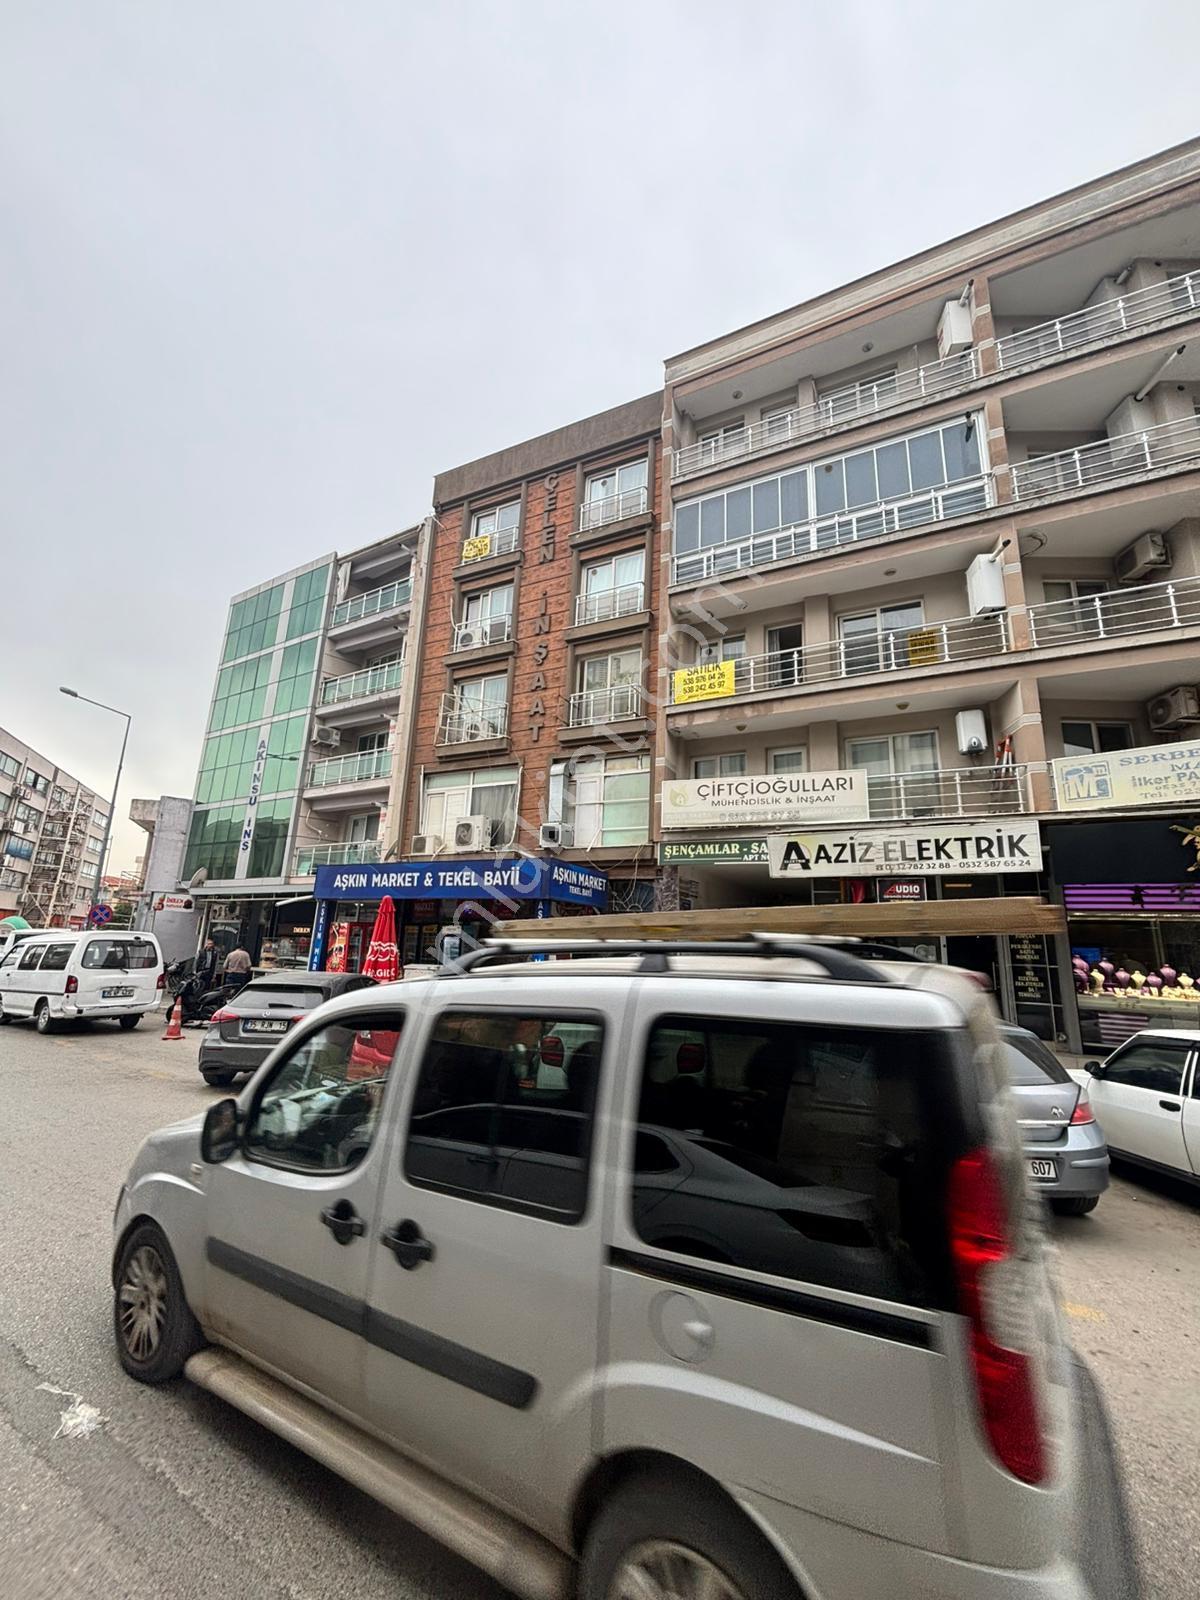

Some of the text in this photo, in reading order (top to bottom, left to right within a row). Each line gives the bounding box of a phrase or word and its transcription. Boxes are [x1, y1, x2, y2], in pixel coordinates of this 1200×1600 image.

[529, 473, 559, 742] ÇELEN İNŞAAT
[697, 777, 854, 801] ÇİFTÇİOĞULLARI
[711, 796, 781, 807] MÜHENDİSLİK
[797, 794, 836, 804] İNŞAAT
[664, 843, 740, 857] ŞENÇAMLAR
[814, 829, 1030, 864] AZİZ ELEKTRİK
[908, 862, 924, 870] 782
[926, 862, 937, 870] 32
[959, 861, 982, 869] 0532
[334, 873, 368, 891] AŞKIN
[371, 872, 420, 888] MARKET
[424, 872, 433, 886] &
[438, 871, 478, 888] TEKEL
[553, 866, 607, 891] AŞKIN MARKET
[569, 886, 582, 895] TEKEL
[1031, 1160, 1052, 1176] 607
